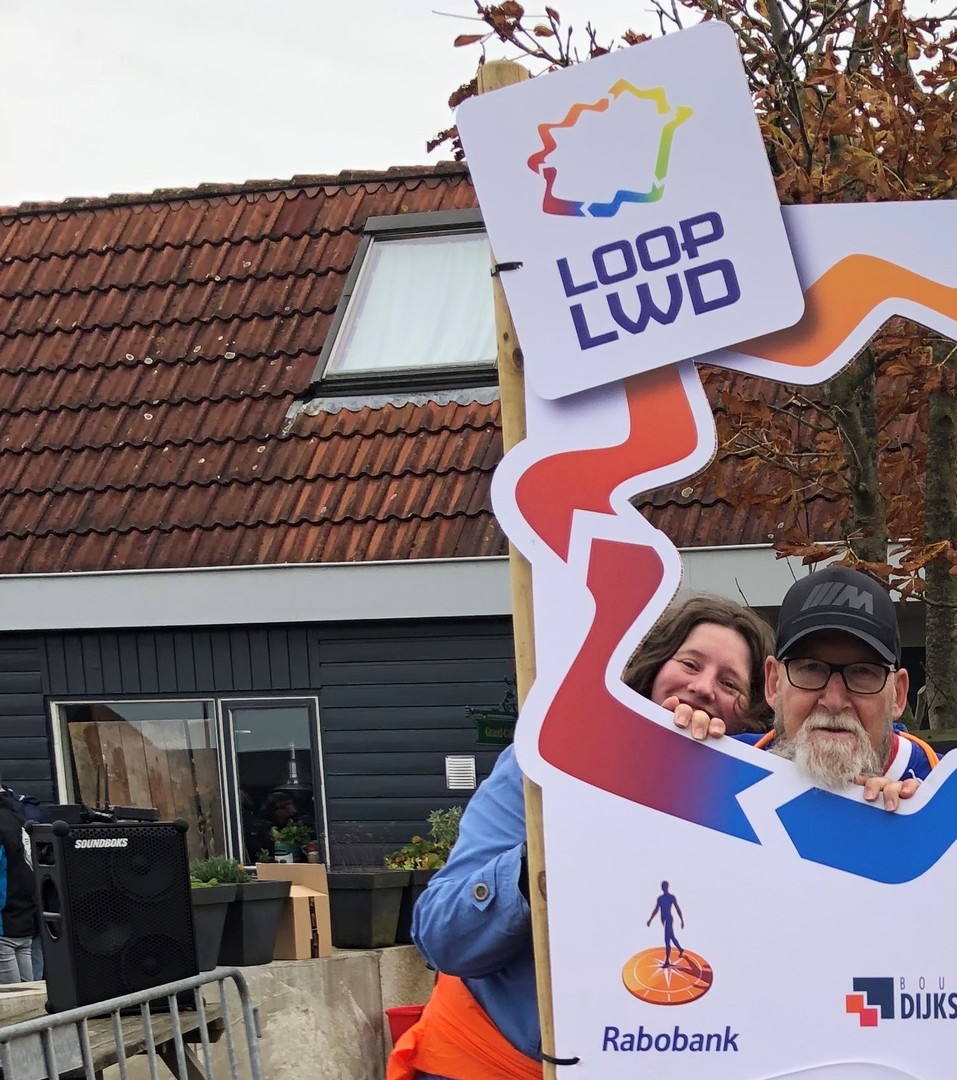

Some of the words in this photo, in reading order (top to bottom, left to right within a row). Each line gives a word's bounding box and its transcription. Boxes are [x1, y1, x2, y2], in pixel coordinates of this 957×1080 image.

[556, 211, 724, 298] LOOP
[569, 259, 741, 351] LWD
[74, 837, 128, 849] SOUNDBOKS
[602, 1025, 740, 1052] Rabobank
